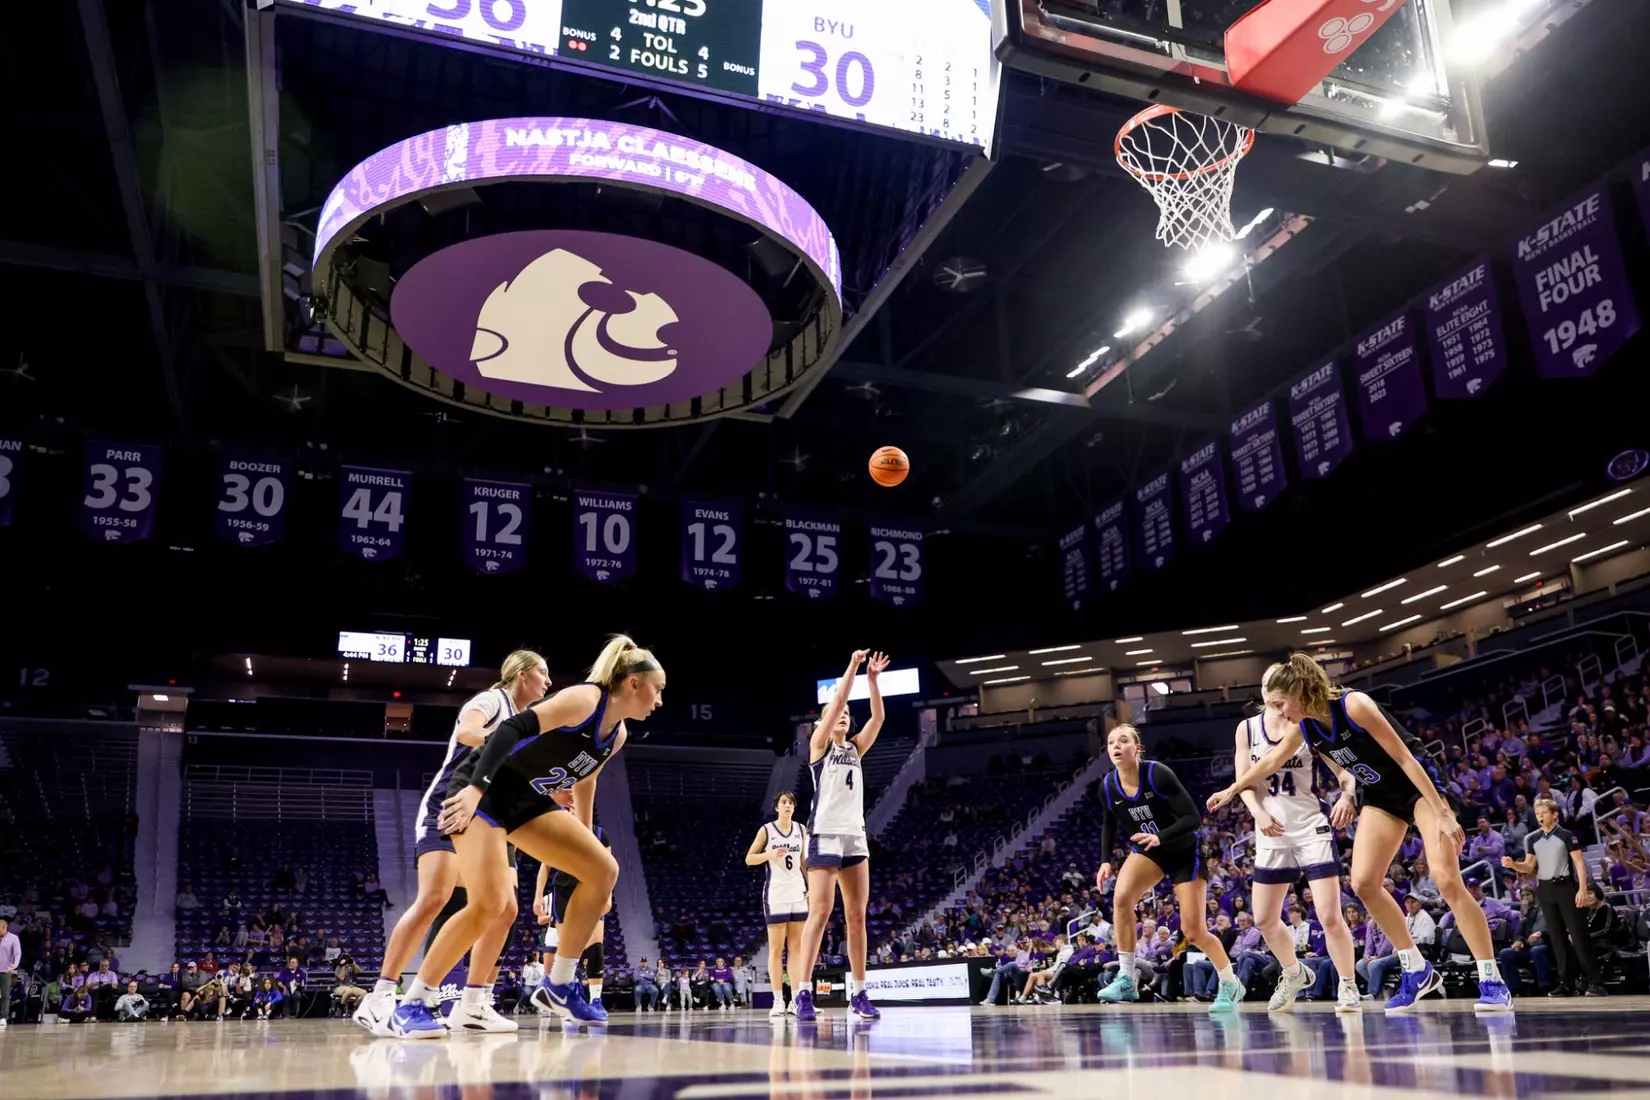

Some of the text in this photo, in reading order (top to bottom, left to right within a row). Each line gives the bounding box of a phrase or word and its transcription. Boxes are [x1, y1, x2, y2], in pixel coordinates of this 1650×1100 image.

[629, 8, 657, 28] 2nd
[658, 15, 686, 35] QTR
[814, 16, 853, 38] BYU
[563, 26, 597, 41] BONUS
[610, 27, 709, 60] 4 TOL 4
[609, 45, 708, 78] 2 FOULS 5
[723, 62, 755, 76] BONUS
[916, 55, 977, 77] 2 2 1
[791, 40, 875, 107] 30
[915, 70, 977, 91] 8 3 1
[912, 83, 977, 106] 11 5 1
[911, 97, 976, 119] 13 2 1
[910, 111, 977, 133] 23 8 2
[506, 127, 612, 149] NASTJA
[569, 152, 662, 176] FORWARD
[1518, 192, 1600, 258] K-STATE
[1548, 214, 1597, 247] BASKETBALL
[1535, 244, 1599, 293] FINAL
[1429, 263, 1485, 309] K-STATE
[1539, 262, 1602, 312] FOUR
[1436, 299, 1488, 338] ELITE EIGHT
[1544, 299, 1617, 355] 1948
[1357, 314, 1406, 356] K-STATE
[1470, 327, 1491, 344] 1972
[1472, 338, 1493, 355] 1973
[1474, 348, 1495, 365] 1975
[1291, 361, 1334, 398] K-STATE
[1231, 401, 1270, 434] K-STATE
[106, 449, 141, 462] PARR
[1181, 441, 1216, 472] K-STATE
[229, 461, 281, 473] BOOZER
[84, 464, 153, 512] 33
[348, 472, 404, 488] MURRELL
[217, 473, 285, 517] 30
[474, 486, 520, 499] KRUGER
[579, 496, 632, 511] WILLIAMS
[342, 488, 404, 532] 44
[695, 509, 729, 520] EVANS
[92, 516, 137, 528] 1955-58
[227, 519, 269, 532] 1956-59
[469, 501, 523, 545] 12
[579, 511, 631, 554] 10
[785, 519, 840, 532] BLACKMAN
[351, 534, 391, 546] 1962-64
[687, 522, 737, 564] 12
[871, 527, 923, 540] RICHMOND
[474, 548, 513, 559] 1971-74
[585, 558, 622, 568] 1972-76
[789, 533, 839, 573] 25
[874, 541, 922, 581] 23
[378, 643, 397, 656] 36
[414, 638, 429, 646] 1:25
[444, 648, 464, 660] 30
[19, 667, 50, 686] 12
[690, 703, 713, 721] 15
[567, 750, 598, 777] BYU
[1329, 746, 1358, 765] BYU
[846, 769, 853, 790] 4
[1266, 771, 1296, 797] 34
[1128, 804, 1153, 821] BYU
[785, 855, 793, 870] 6
